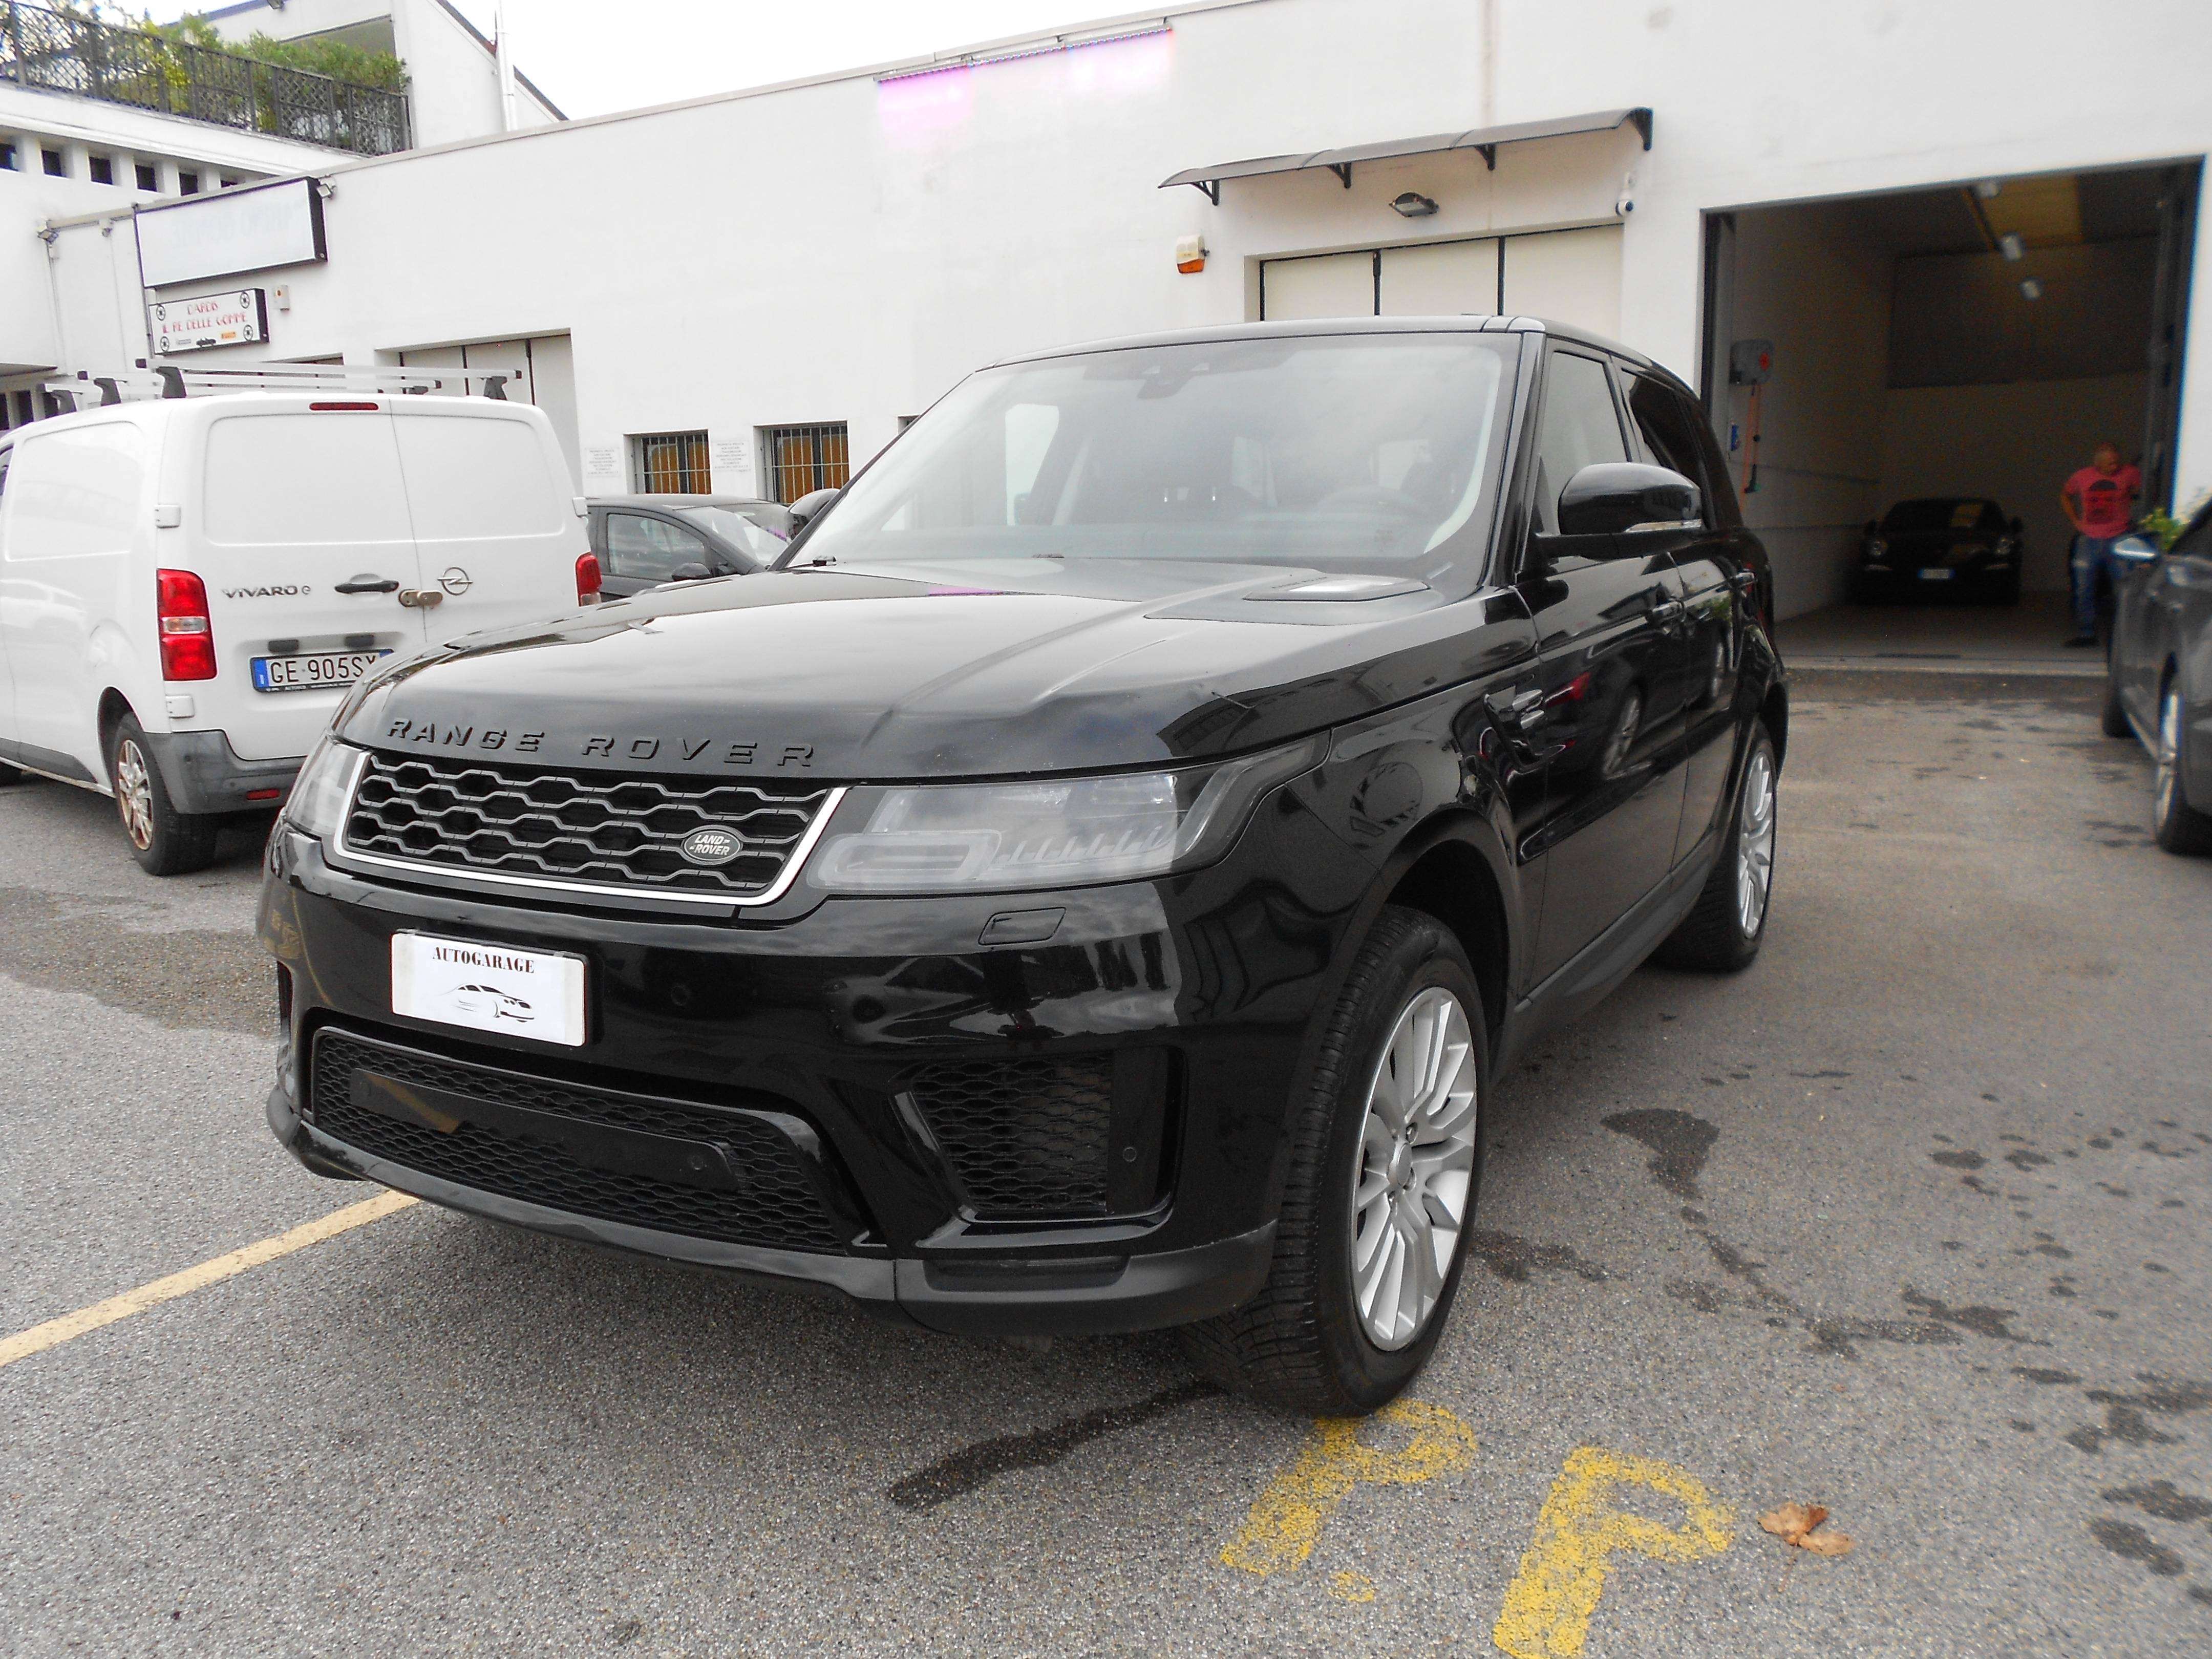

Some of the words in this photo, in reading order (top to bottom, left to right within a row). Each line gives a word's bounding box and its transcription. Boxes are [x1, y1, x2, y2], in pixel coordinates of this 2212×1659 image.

[222, 586, 298, 599] VIVARO
[270, 661, 300, 684] GE
[387, 718, 545, 753] RANGE
[582, 736, 815, 767] ROVER
[694, 835, 725, 845] LAND
[694, 844, 730, 856] ROVER
[432, 946, 535, 973] AUTOGARAGE
